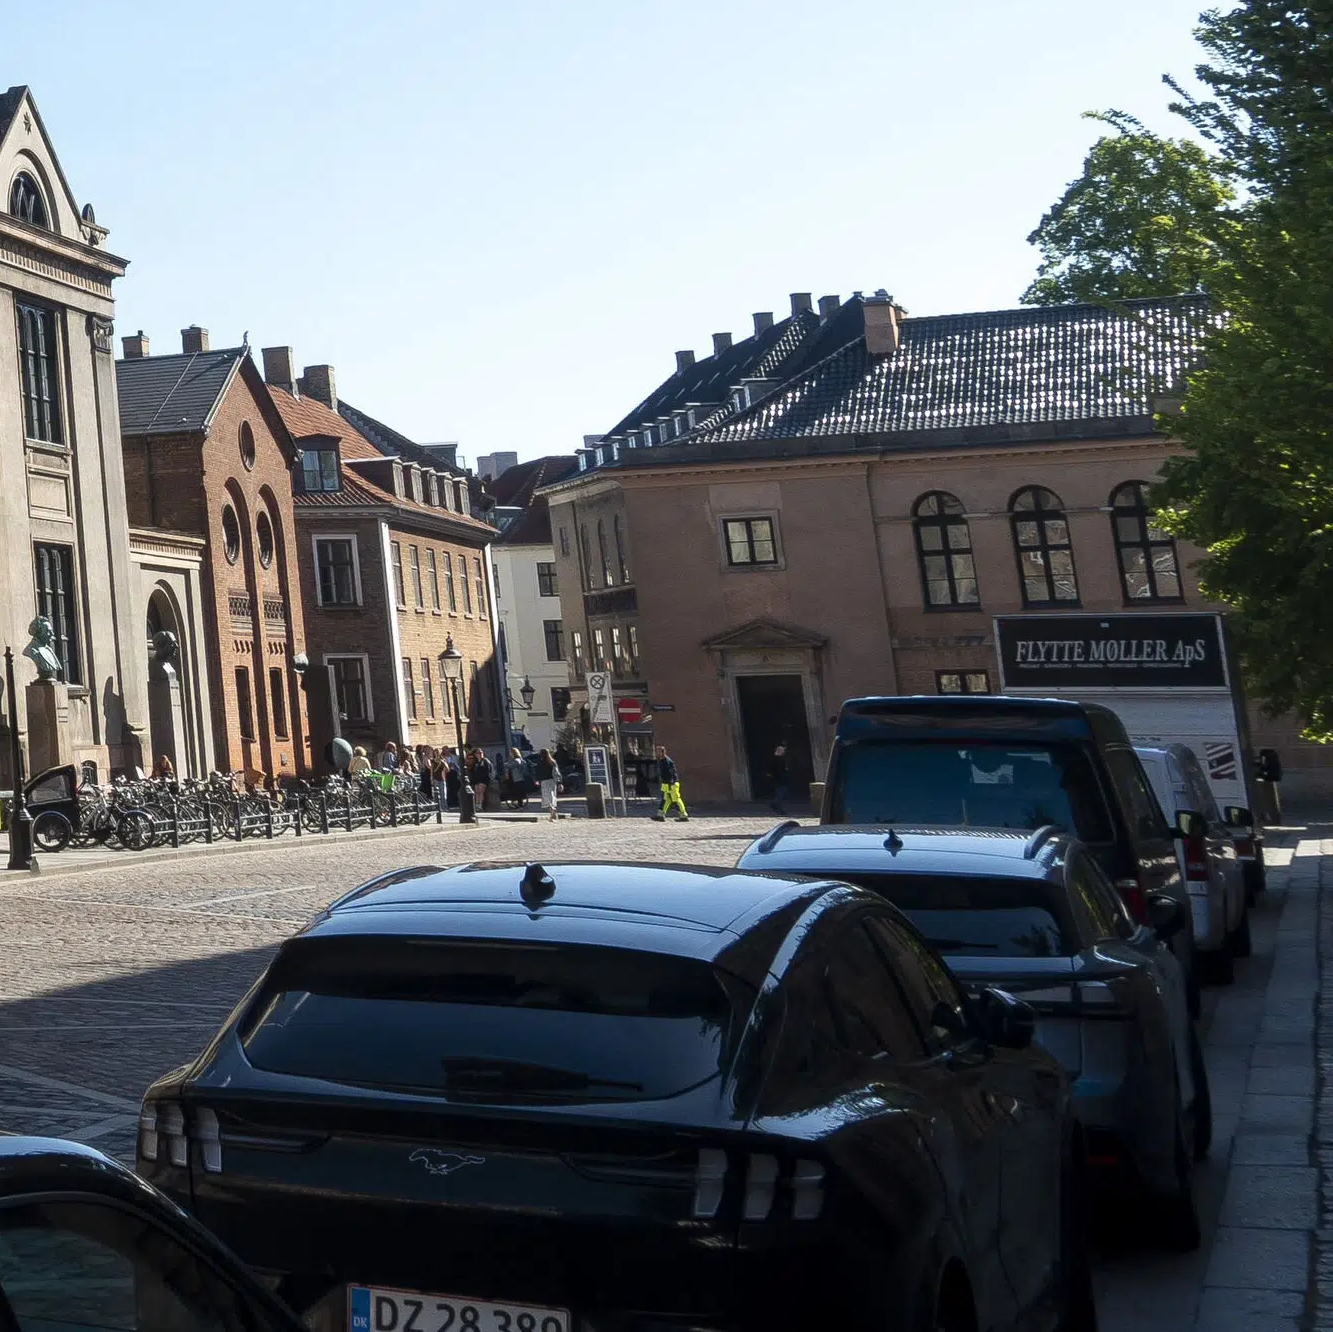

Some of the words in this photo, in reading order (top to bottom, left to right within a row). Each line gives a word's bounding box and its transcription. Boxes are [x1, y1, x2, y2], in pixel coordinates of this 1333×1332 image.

[1015, 640, 1084, 662] FLYTTE
[1088, 640, 1168, 662] MØLLER
[1172, 639, 1206, 668] ApS
[353, 1315, 368, 1329] DK
[375, 1296, 424, 1332] DZ
[435, 1303, 480, 1332] 28
